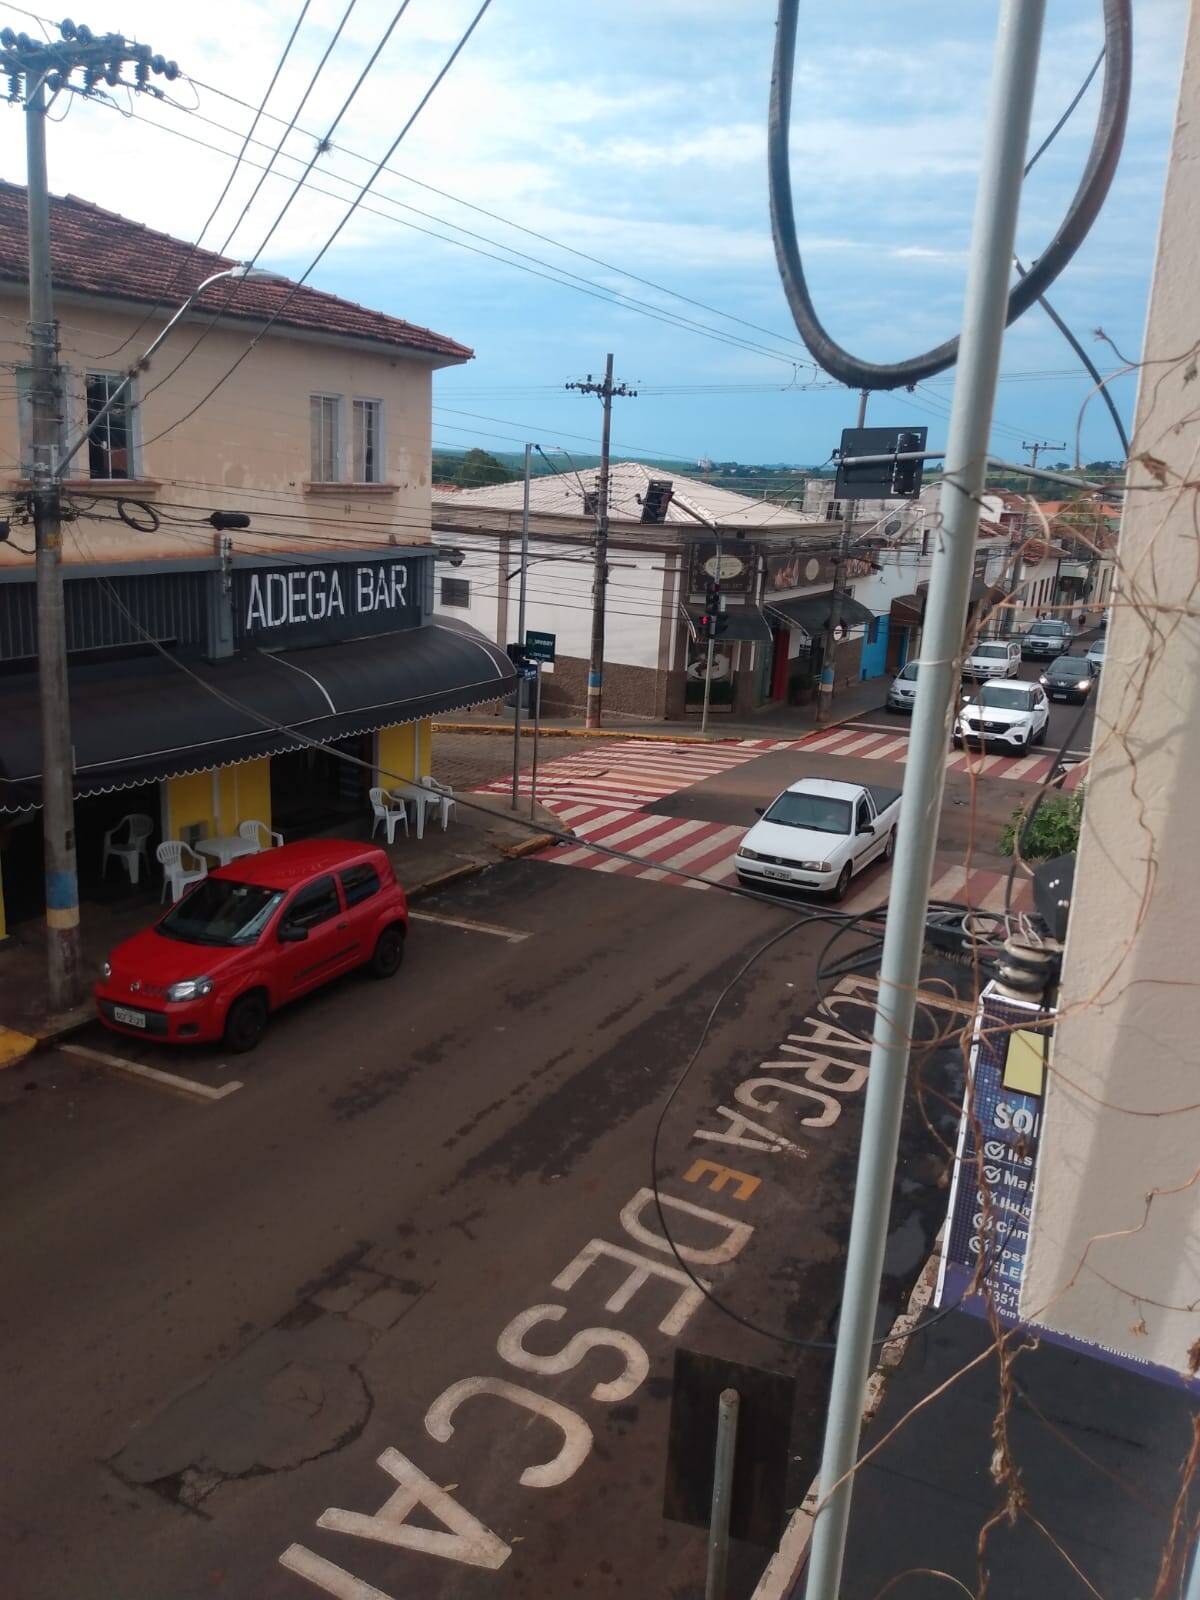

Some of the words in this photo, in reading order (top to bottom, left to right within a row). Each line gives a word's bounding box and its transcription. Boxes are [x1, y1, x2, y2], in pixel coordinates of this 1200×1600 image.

[246, 568, 345, 630] ADEGA
[357, 564, 408, 613] BAR
[681, 1157, 763, 1202] E
[277, 1186, 757, 1600] DESCA
